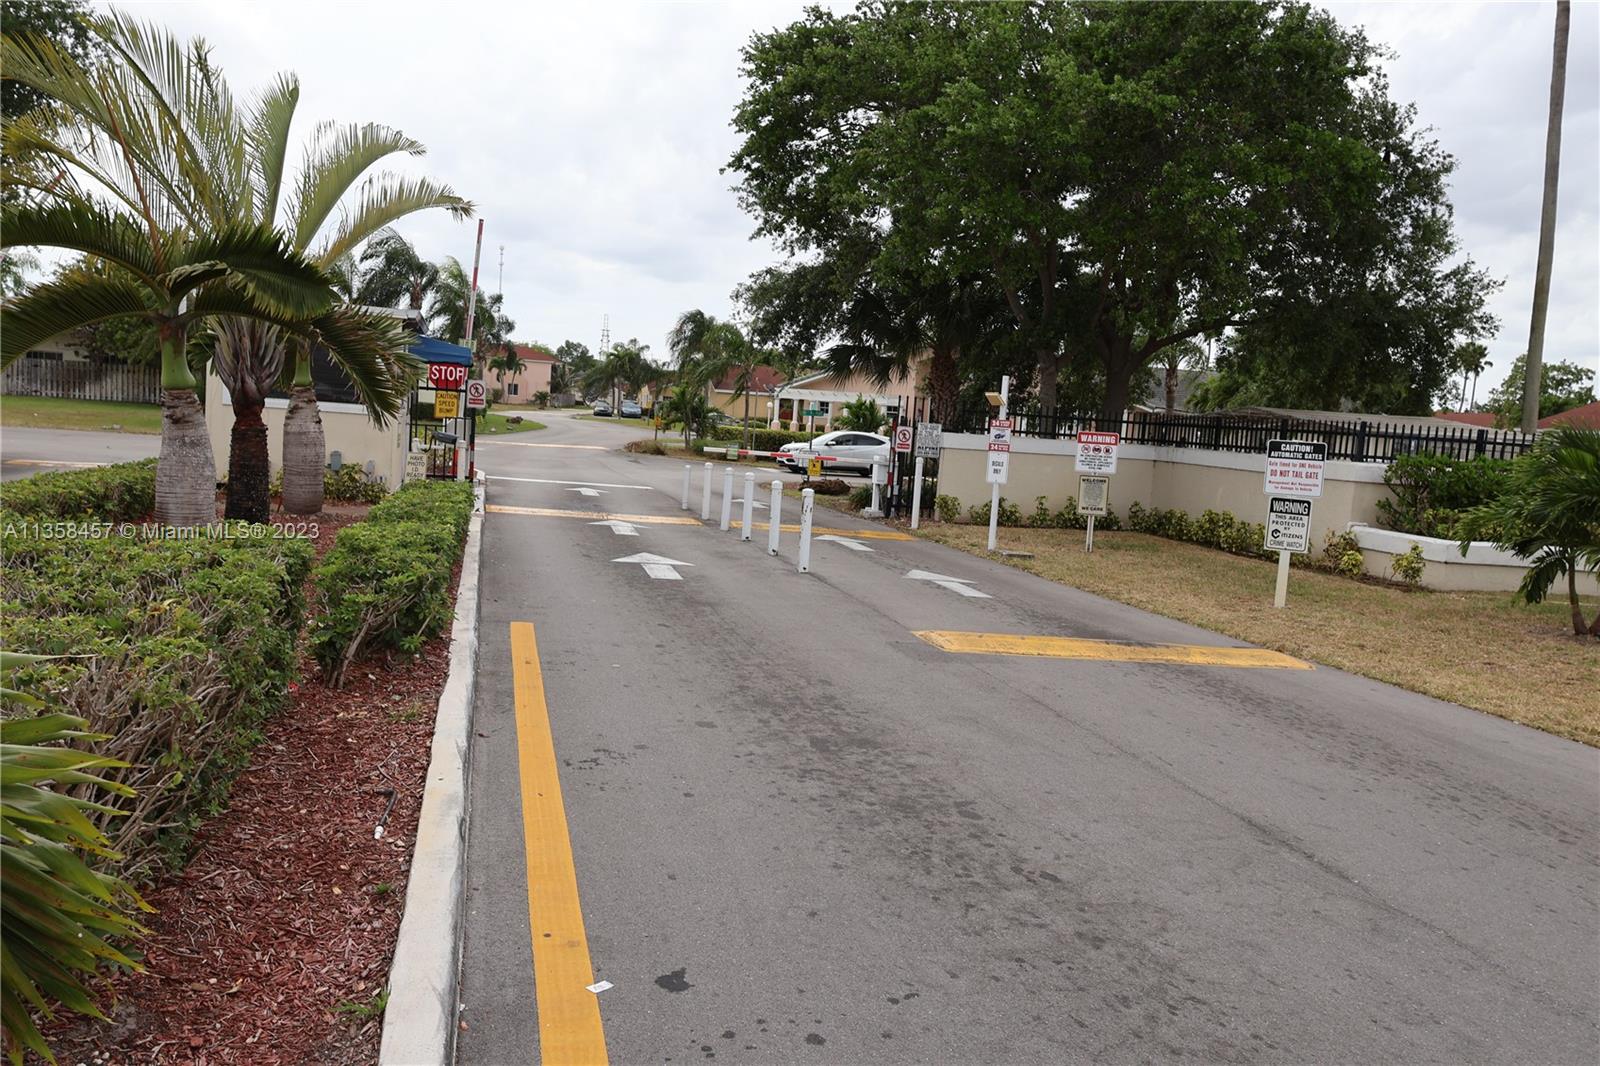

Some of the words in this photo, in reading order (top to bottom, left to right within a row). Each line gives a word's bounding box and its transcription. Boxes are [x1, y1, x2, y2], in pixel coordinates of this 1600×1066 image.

[431, 365, 464, 381] STOP
[1080, 434, 1116, 443] WARNING
[1281, 443, 1314, 453] CAUTION!
[1270, 451, 1303, 459] AUTOMATIC
[1270, 469, 1278, 477] DO
[1292, 470, 1303, 479] TAIL
[1304, 471, 1319, 480] GATE
[1272, 500, 1309, 515] WARNING
[1271, 519, 1306, 528] PROTECTED
[1269, 539, 1286, 547] CRIME
[1286, 541, 1303, 549] WATCH
